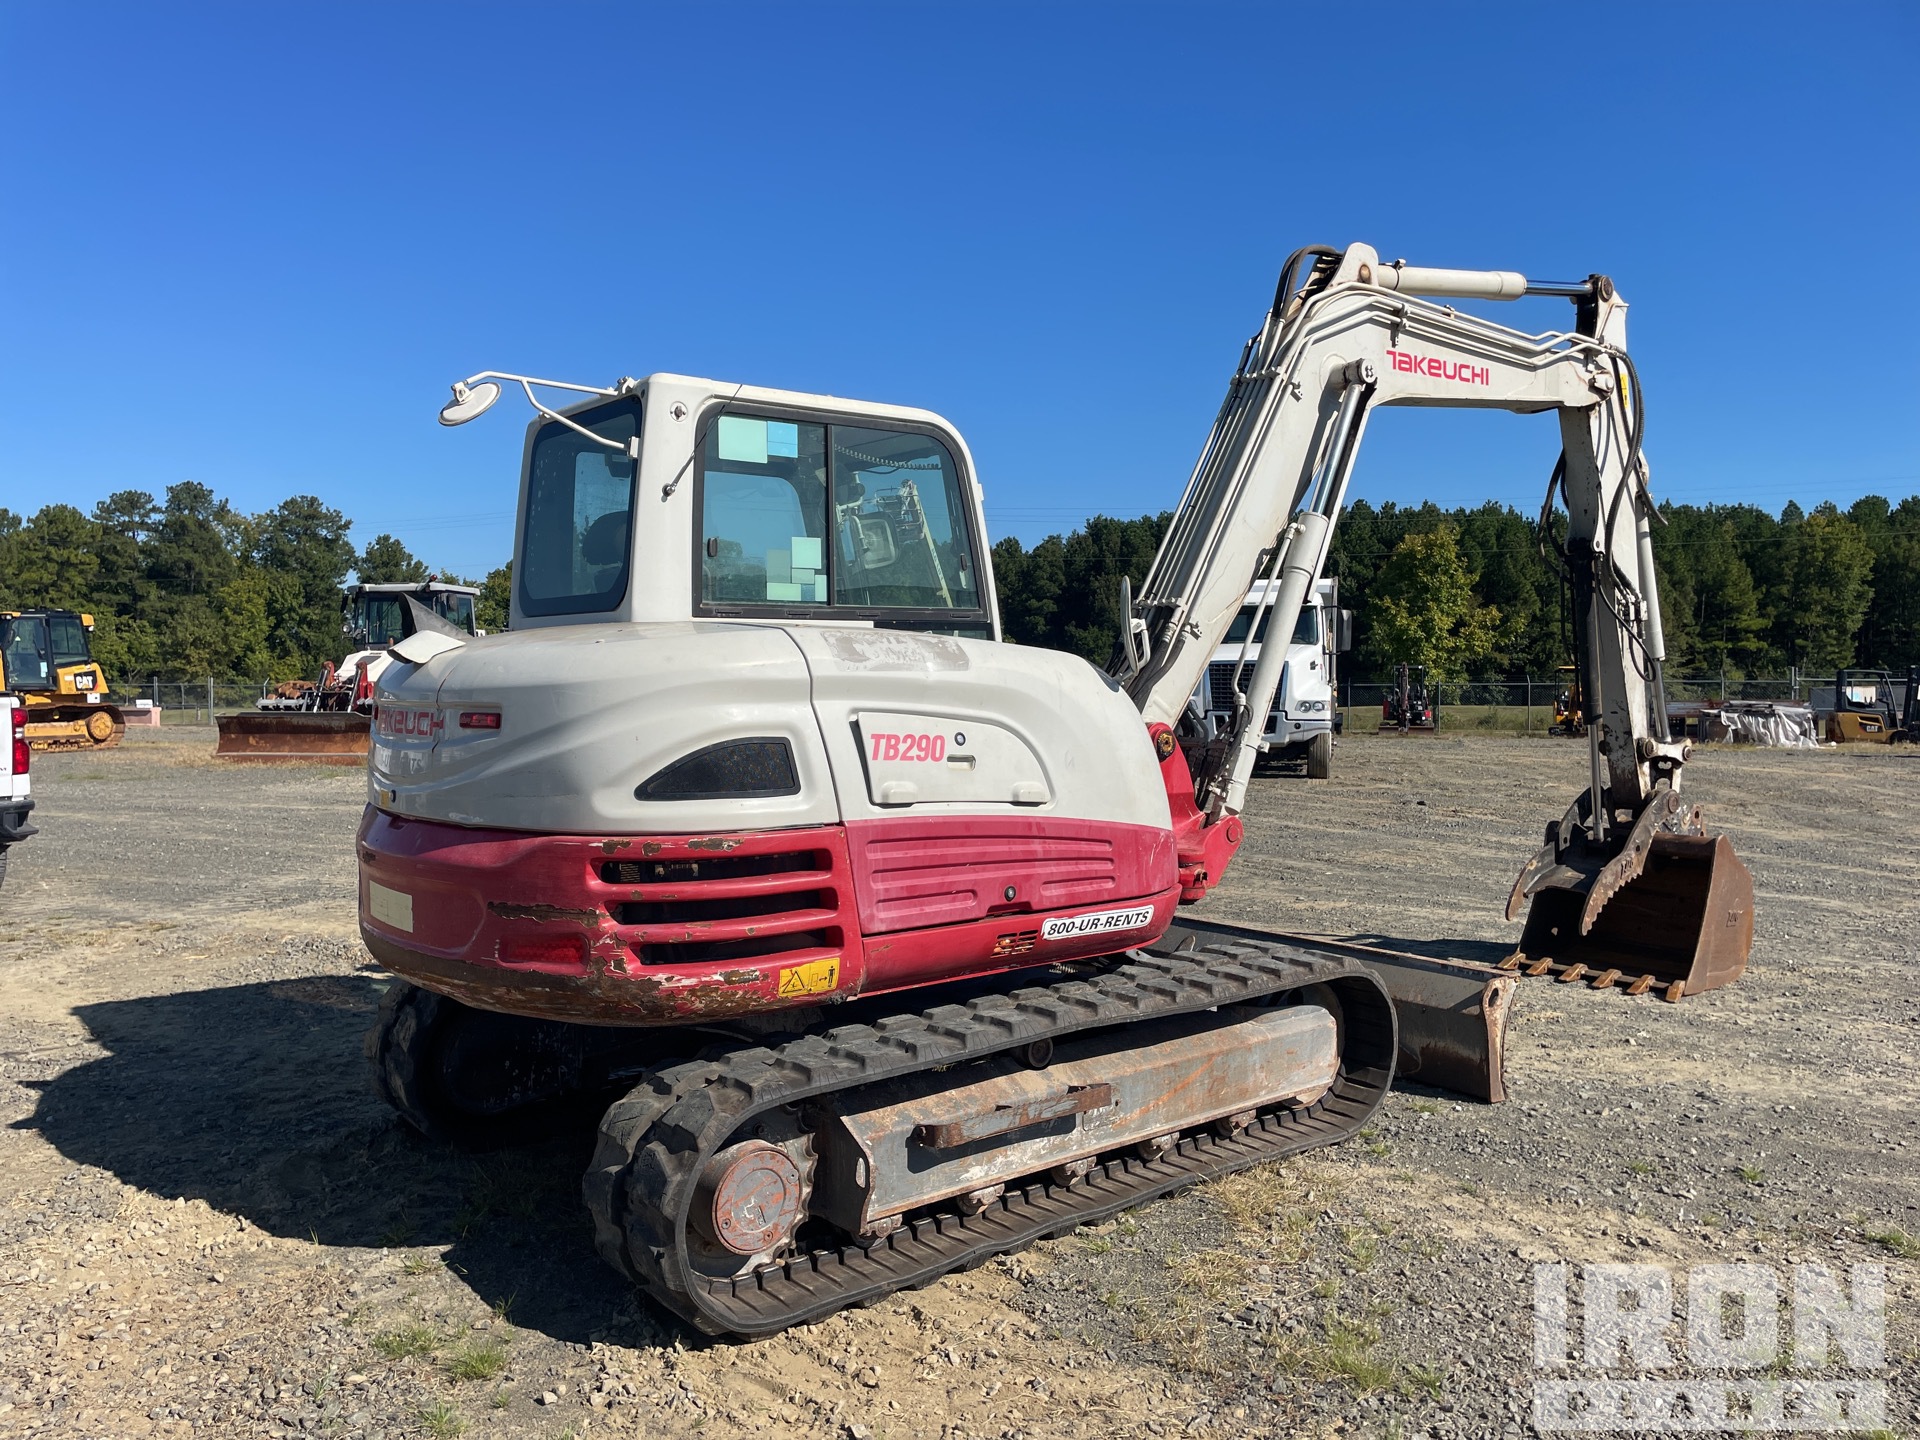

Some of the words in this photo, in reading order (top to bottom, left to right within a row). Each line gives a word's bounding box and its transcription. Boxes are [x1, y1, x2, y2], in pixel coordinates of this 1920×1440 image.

[75, 675, 94, 689] CAT
[870, 733, 946, 763] TB290
[1047, 910, 1150, 936] 800-UR-RENTS
